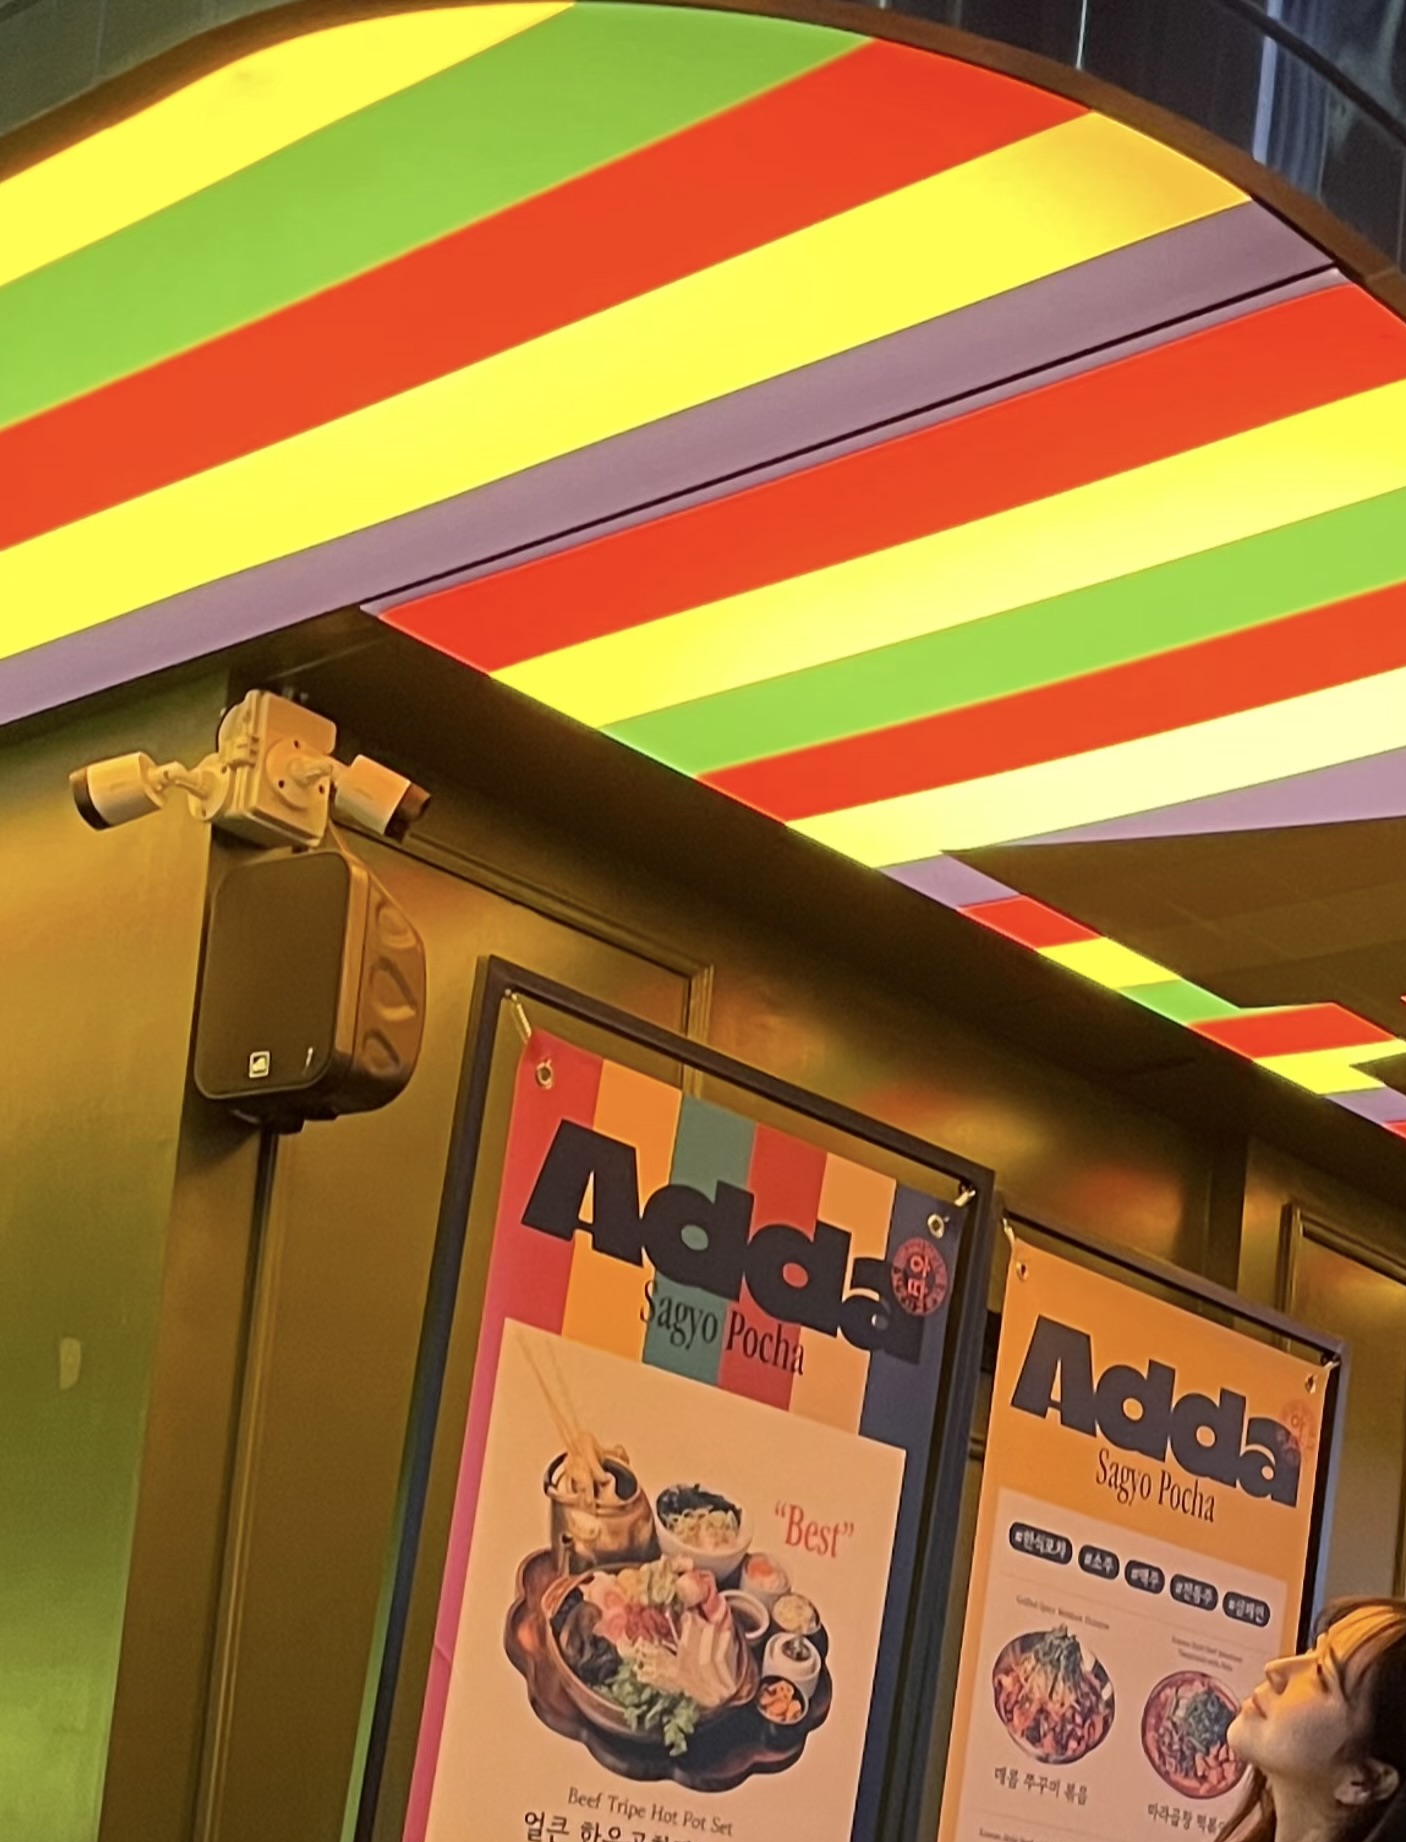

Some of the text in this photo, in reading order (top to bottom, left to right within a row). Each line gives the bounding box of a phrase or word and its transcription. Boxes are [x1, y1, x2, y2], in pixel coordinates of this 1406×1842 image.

[521, 1118, 925, 1365] Adda
[640, 1279, 805, 1376] Sagyo Pocha
[1011, 1314, 1301, 1508] Adda
[1096, 1447, 1215, 1523] Sagyo Pocha
[1084, 1552, 1114, 1575] #소주
[568, 1787, 734, 1838] Beef Tripe Hot Pot Set
